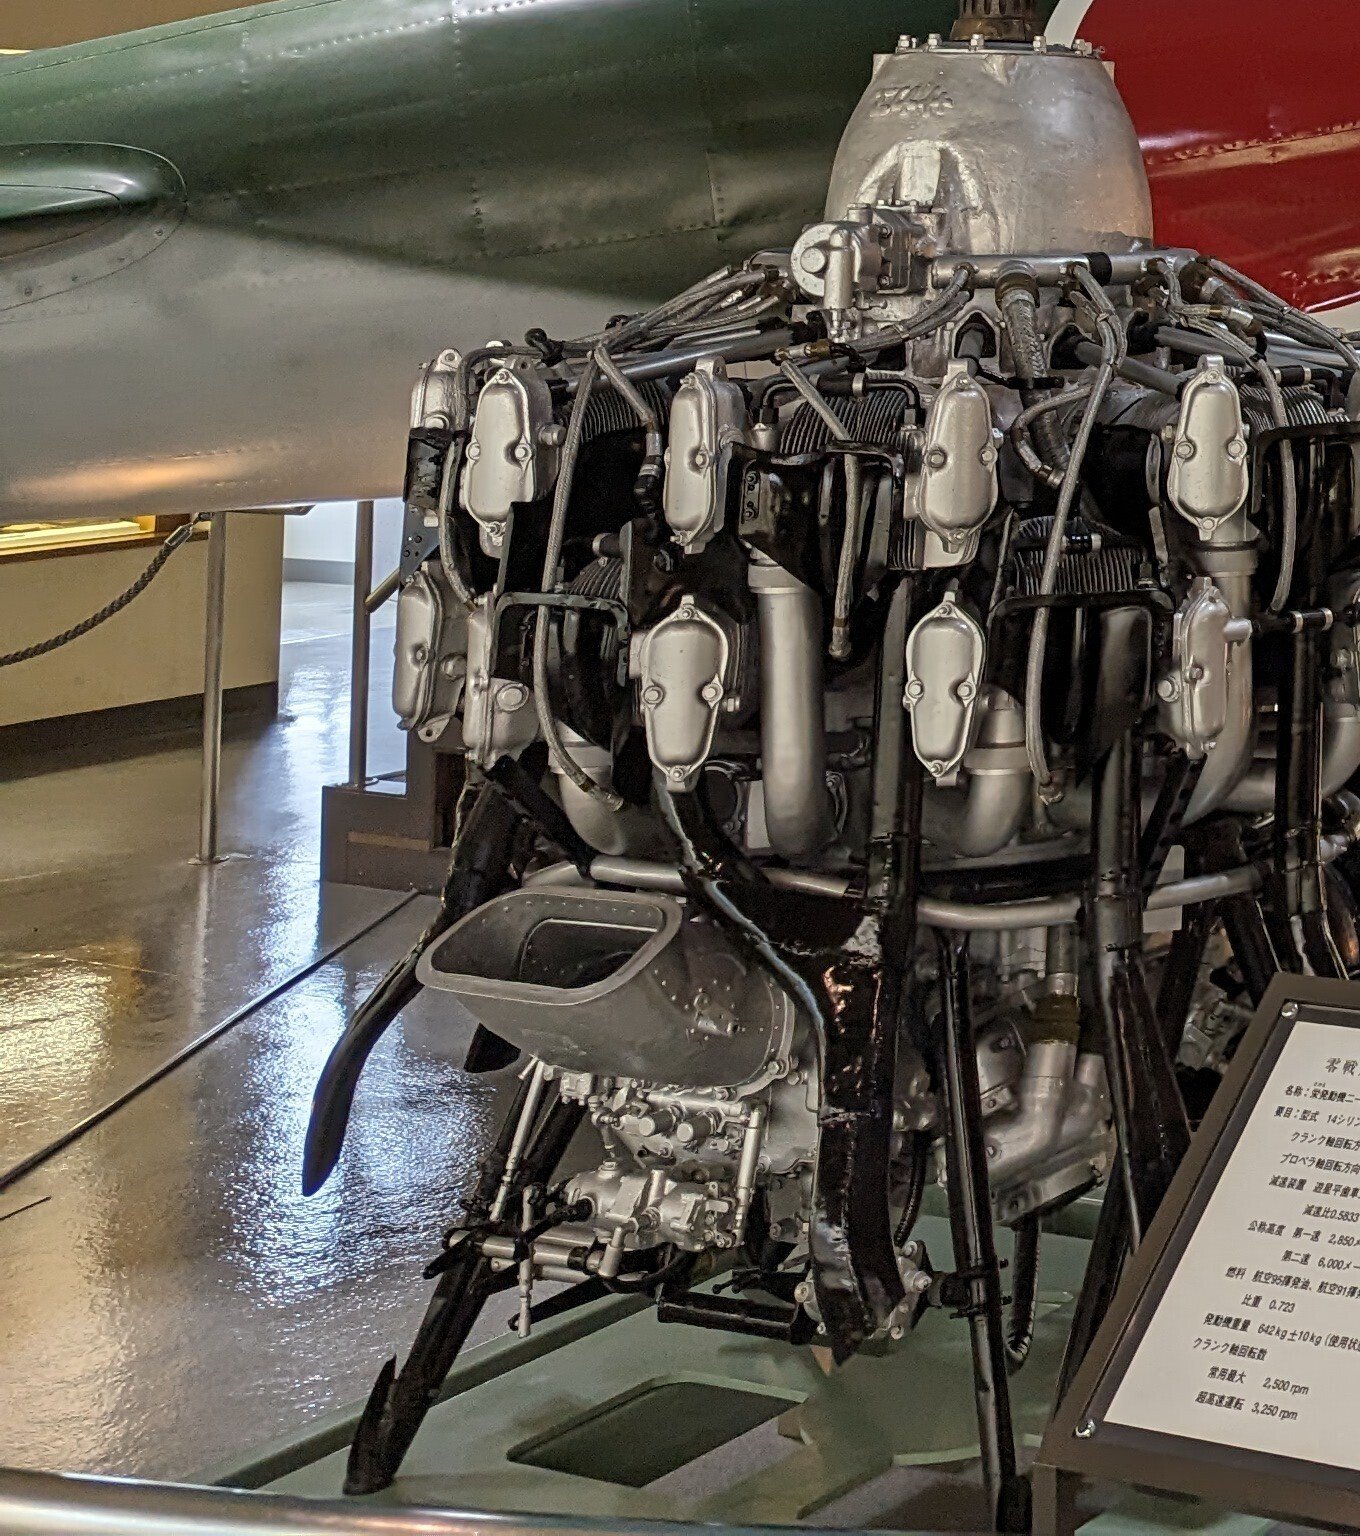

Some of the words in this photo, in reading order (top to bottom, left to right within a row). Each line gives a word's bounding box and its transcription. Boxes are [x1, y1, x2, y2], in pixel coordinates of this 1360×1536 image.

[1280, 1152, 1360, 1174] プロペラ軸回転方向
[1268, 1174, 1306, 1190] 減速装置
[1247, 1220, 1286, 1236] 公称高度
[1291, 1226, 1321, 1242] 第一速
[1281, 1249, 1311, 1265] 第二速
[1225, 1266, 1246, 1279] 燃料
[1240, 1293, 1262, 1307] 比重
[1268, 1299, 1295, 1313] 0.723
[1203, 1312, 1250, 1332] 発動機重量
[1193, 1337, 1267, 1360] クランク軸回転数
[1207, 1365, 1246, 1383] 常用最大
[1194, 1390, 1245, 1410] 超高速運転
